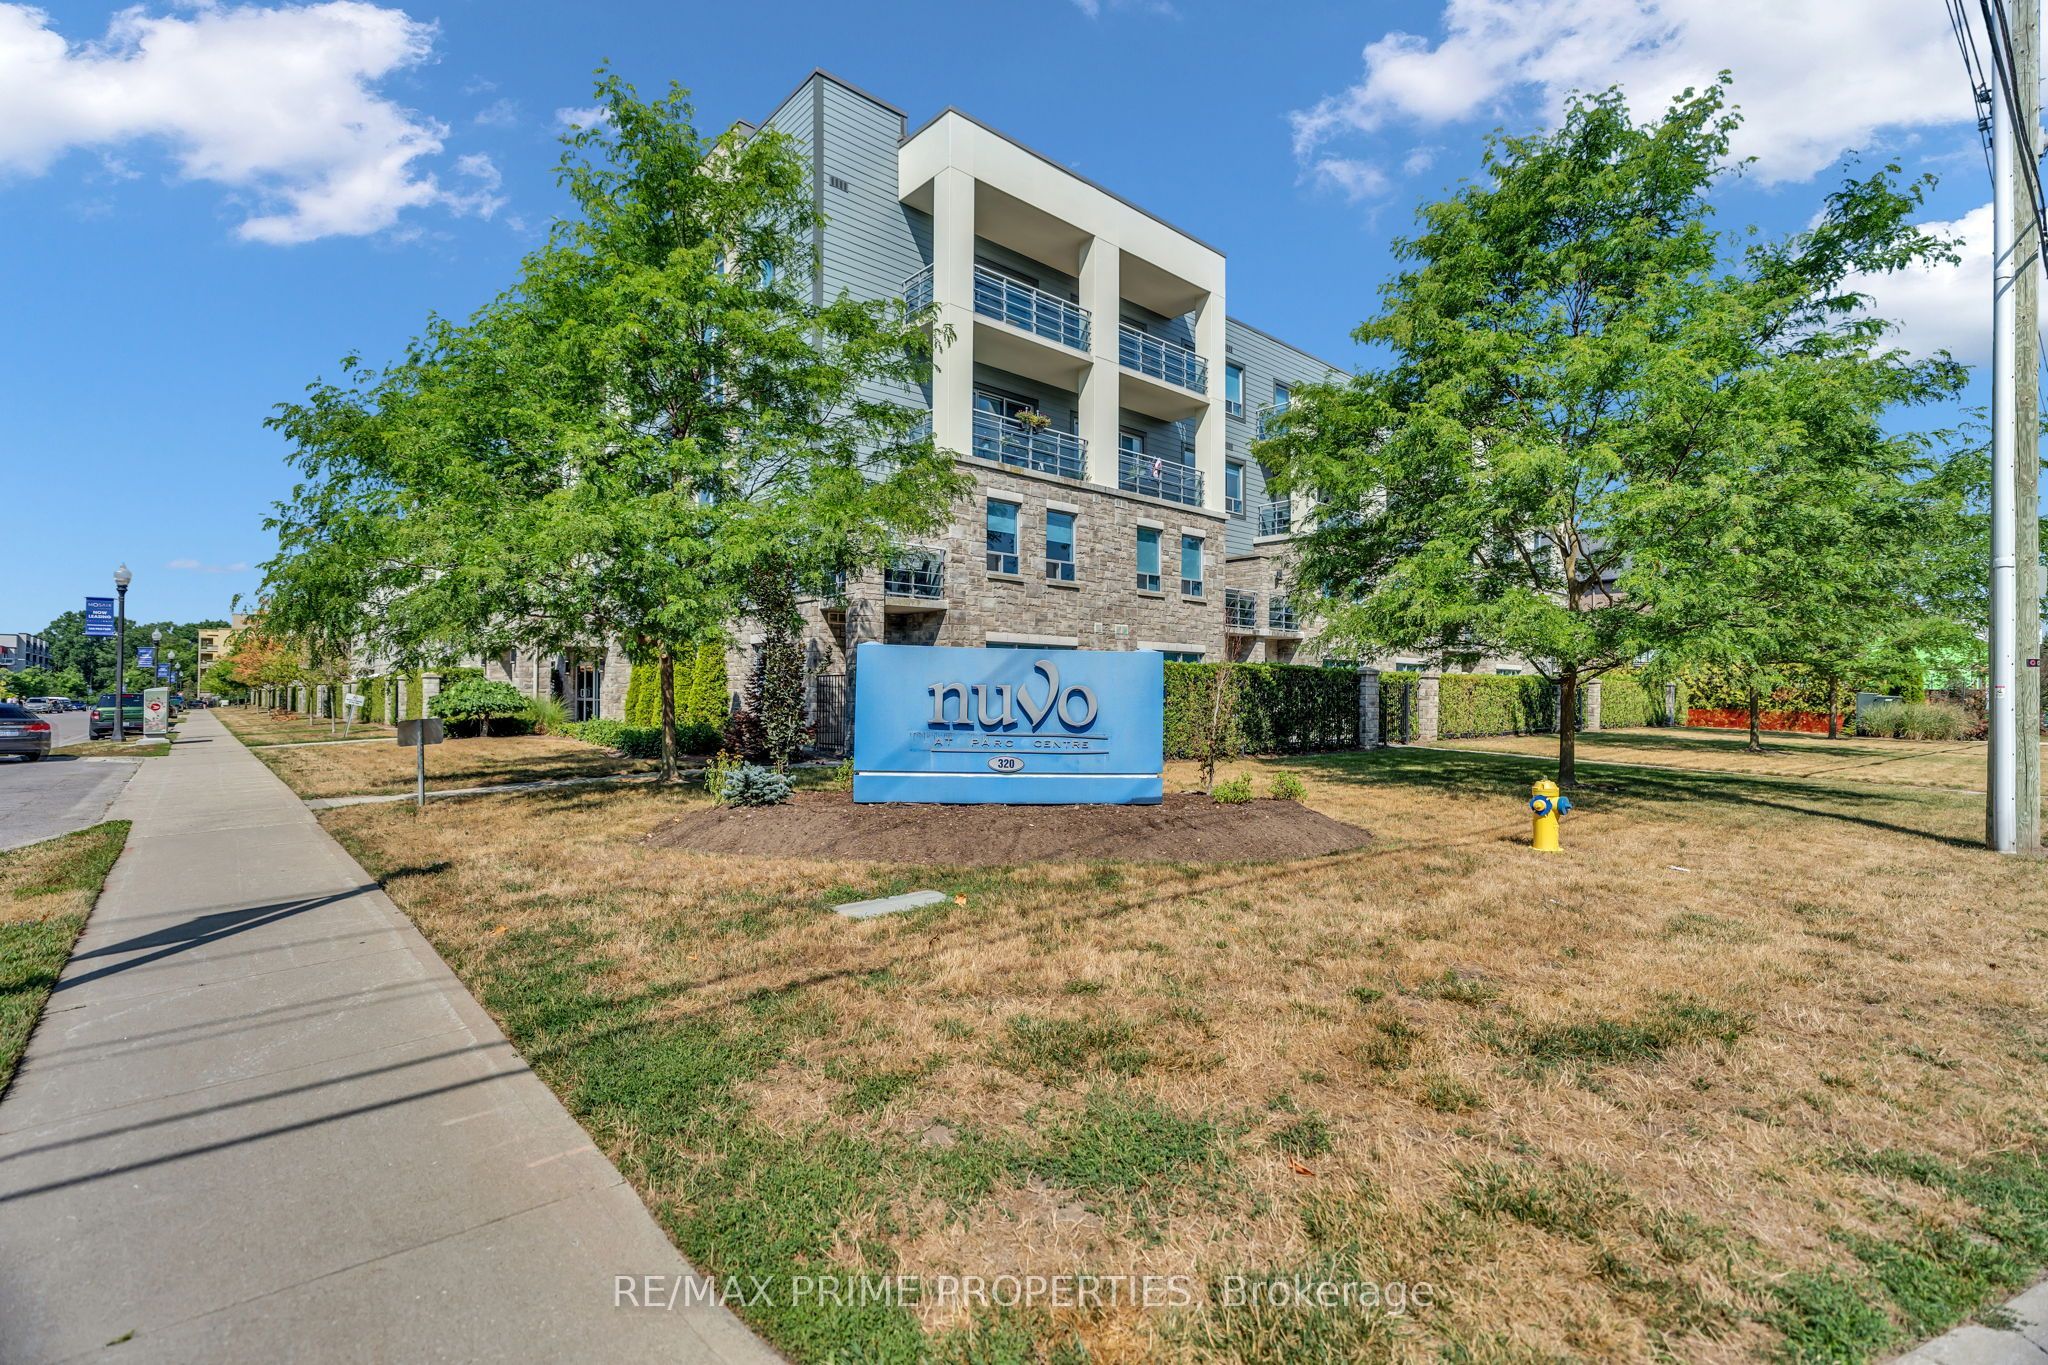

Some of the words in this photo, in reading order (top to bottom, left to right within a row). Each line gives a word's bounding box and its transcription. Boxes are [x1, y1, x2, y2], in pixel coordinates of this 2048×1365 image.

[934, 738, 953, 748] AT
[971, 739, 1014, 748] PARC
[1033, 740, 1090, 749] CENTRE
[997, 758, 1015, 769] 320
